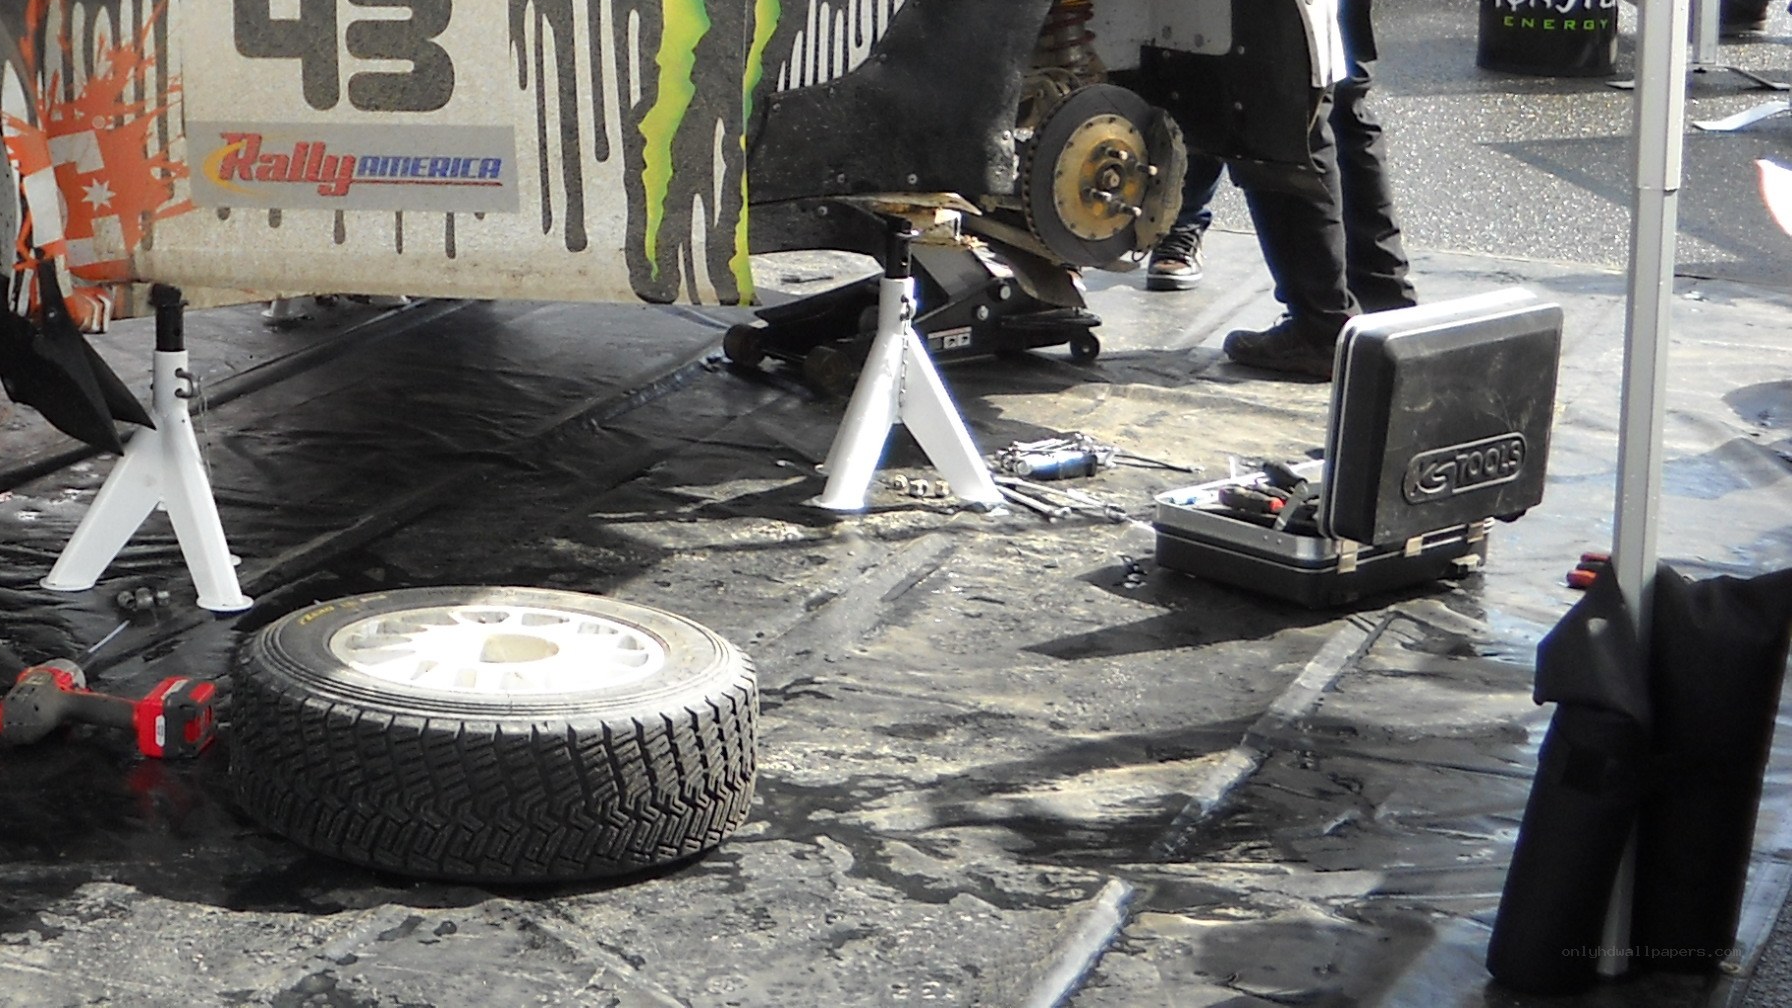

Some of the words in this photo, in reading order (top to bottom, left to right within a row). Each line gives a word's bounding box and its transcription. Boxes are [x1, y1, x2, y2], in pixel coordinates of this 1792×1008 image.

[1503, 15, 1609, 31] ENERGY
[218, 131, 358, 197] Rally
[356, 154, 503, 180] AMERICA
